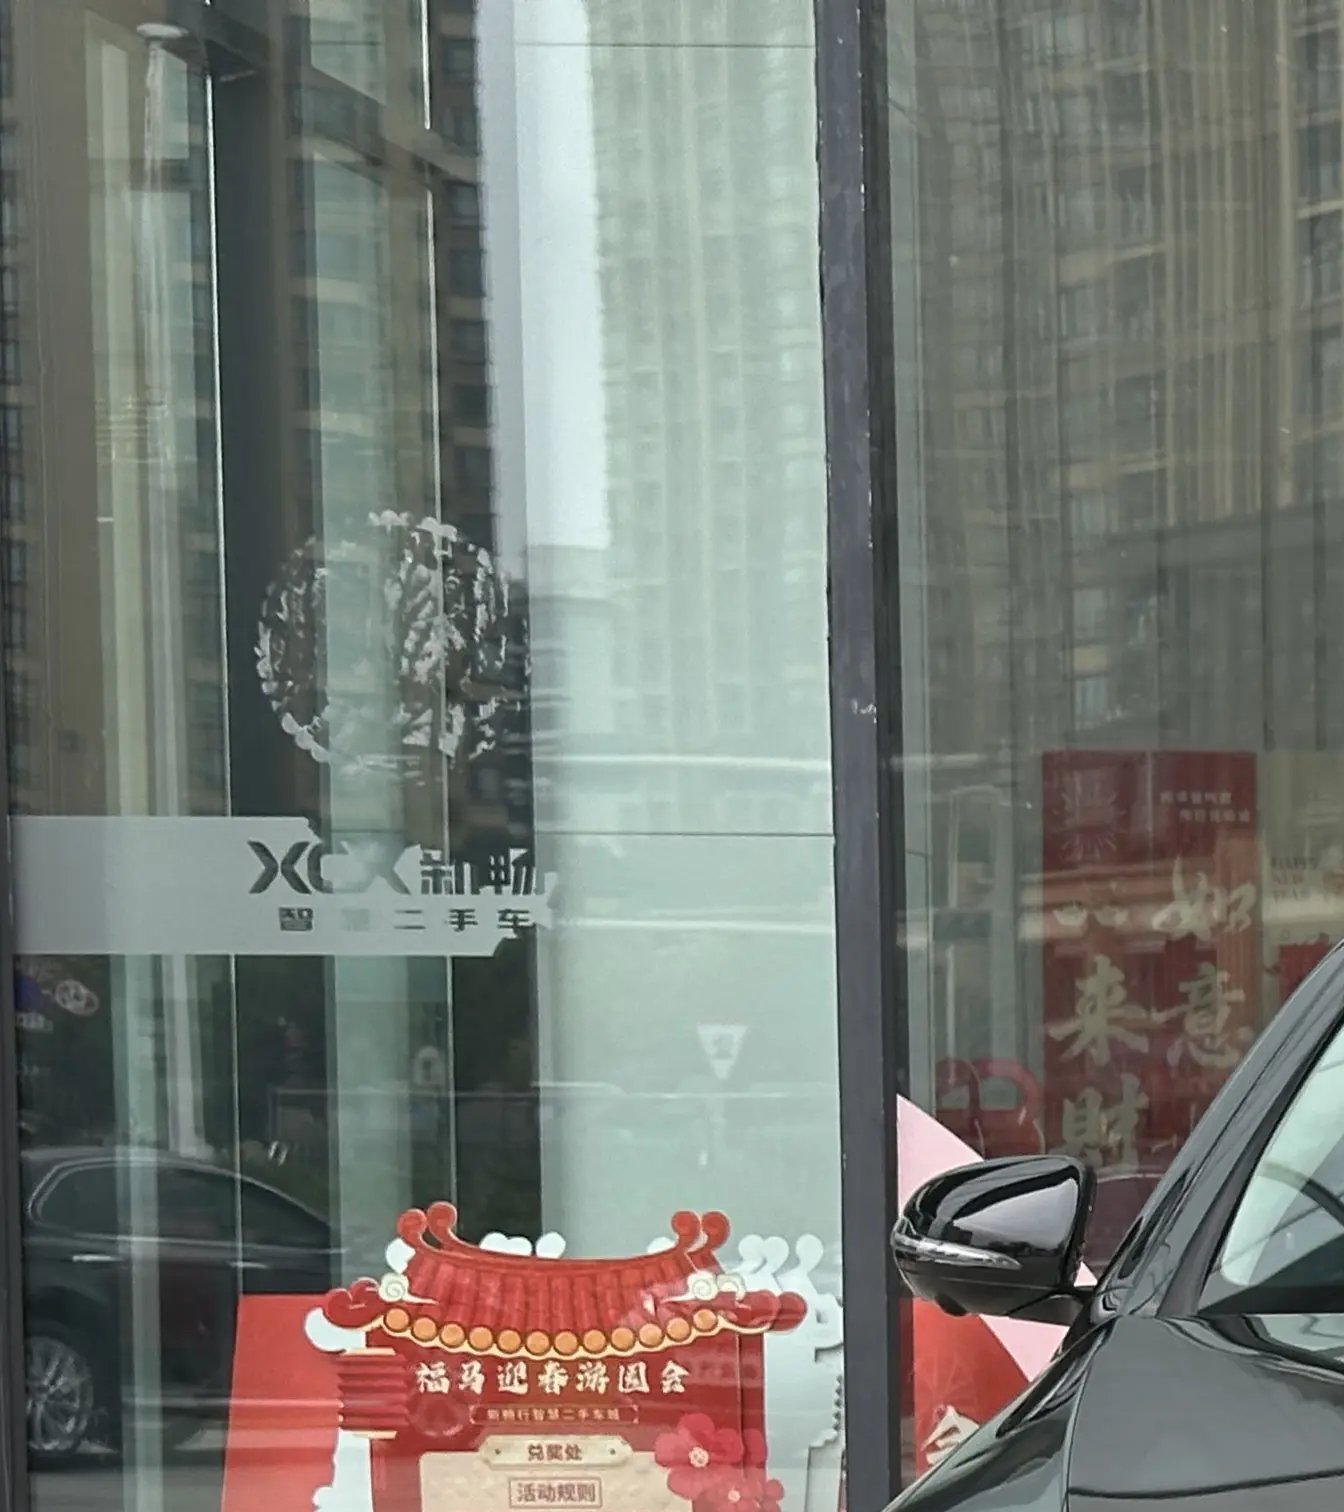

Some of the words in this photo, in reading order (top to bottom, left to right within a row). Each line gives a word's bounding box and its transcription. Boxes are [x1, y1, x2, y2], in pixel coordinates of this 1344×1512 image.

[278, 905, 533, 935] 智二手车
[527, 1443, 583, 1463] 兑奖处
[516, 1481, 597, 1503] 活动规则
